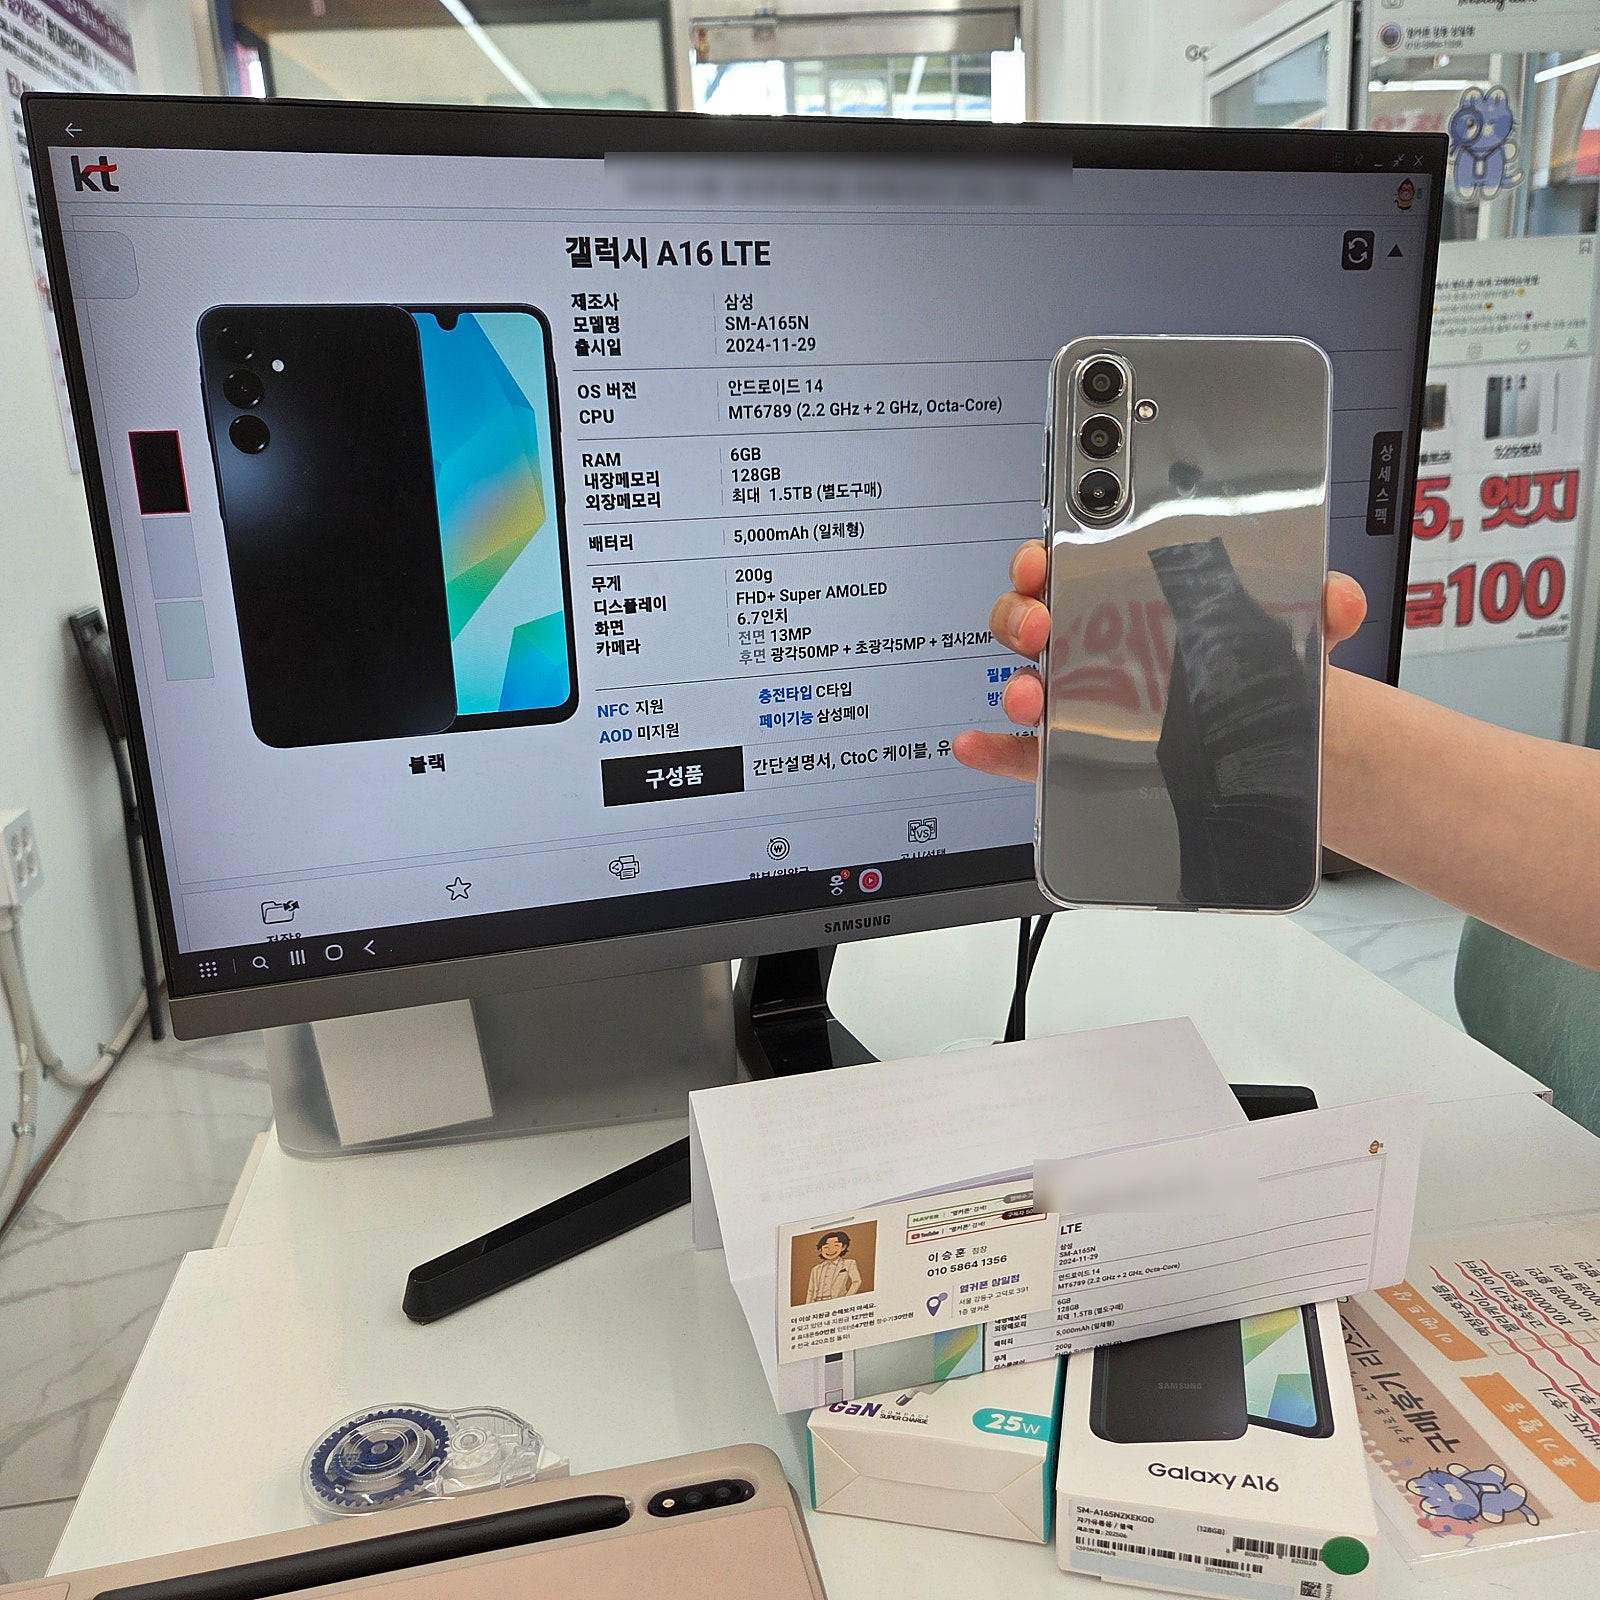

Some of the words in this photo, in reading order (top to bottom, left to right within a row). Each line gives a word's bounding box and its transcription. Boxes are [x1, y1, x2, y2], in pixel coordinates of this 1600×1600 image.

[71, 155, 119, 191] kt
[565, 236, 647, 269] 갤럭시
[657, 240, 713, 267] A16
[721, 240, 771, 266] LTE
[571, 293, 619, 311] 제조사
[725, 294, 754, 311] 삼성
[573, 317, 620, 334] 모델명
[725, 316, 809, 331] SM-A165N
[574, 339, 622, 357] 출시일
[726, 337, 816, 353] 2024-11-29
[577, 384, 601, 400] OS
[606, 381, 637, 400] 버전
[728, 379, 800, 396] 안드로이드
[805, 379, 824, 393] 14
[579, 409, 614, 424] CPU
[728, 404, 792, 420] MT6789
[796, 402, 826, 421] (2.2
[830, 402, 859, 417] GHz
[864, 405, 872, 414] +
[876, 402, 886, 415] 2
[889, 400, 922, 417] GHz,
[926, 396, 1002, 415] Octa-Core)
[582, 452, 621, 468] RAM
[730, 447, 761, 462] 6GB
[584, 470, 660, 490] 내장메모리
[731, 467, 781, 483] 128GB
[1374, 444, 1394, 525] 상세스펙
[585, 491, 662, 511] 외장메모리
[732, 487, 760, 505] 최대
[769, 485, 813, 502] 1.5TB
[816, 481, 883, 502] (별도구매)
[588, 534, 633, 552] 배터리
[734, 525, 809, 546] 5,000mAh
[812, 522, 865, 543] (일체형)
[592, 575, 621, 593] 무게
[735, 568, 773, 584] 200g
[736, 591, 776, 605] FHD+
[780, 588, 822, 604] Super
[825, 582, 887, 599] AMOLED
[594, 595, 667, 616] 디스플레이
[737, 608, 788, 626] 6.7인치
[595, 619, 624, 637] 화면
[738, 629, 766, 646] 전면
[770, 627, 812, 643] 13MP
[596, 638, 641, 657] 카메라
[739, 649, 766, 666] 후면
[770, 644, 839, 663] 광각50MP
[843, 645, 851, 654] +
[855, 637, 926, 655] 초광각5MP
[930, 638, 938, 647] +
[758, 685, 812, 704] 충전타입
[815, 681, 852, 699] C타입
[597, 703, 629, 718] NFC
[635, 699, 664, 716] 지원
[759, 710, 813, 729] 페이기능
[816, 704, 869, 724] 삼성페이
[599, 728, 633, 744] AOD
[637, 722, 680, 741] 미지원
[408, 752, 446, 775] 블랙
[753, 752, 836, 776] 간단설명서,
[840, 749, 879, 766] CtoC
[883, 740, 932, 763] 케이블,
[645, 765, 704, 790] 구성품
[824, 914, 892, 933] SAMSUNG
[1060, 1222, 1082, 1235] LTE
[1059, 1246, 1096, 1258] SM-A165N
[1060, 1243, 1073, 1251] 삼성
[927, 1266, 947, 1277] 010
[950, 1260, 979, 1273] 5864
[981, 1255, 1008, 1267] 1356
[1059, 1253, 1099, 1266] 2024-11-29
[992, 1273, 1020, 1288] 상일점
[1058, 1279, 1086, 1290] MT6789
[1087, 1277, 1101, 1286] (2.2
[1101, 1274, 1116, 1282] GHz
[1128, 1270, 1144, 1278] GHz,
[1145, 1261, 1181, 1274] Octa-Core)
[1092, 1268, 1100, 1276] 14
[1461, 1260, 1495, 1285] 어댑터
[1500, 1271, 1529, 1287] 할인
[1525, 1267, 1553, 1284] 할인
[1549, 1265, 1578, 1281] 할인
[1016, 1286, 1029, 1295] 391
[1056, 1298, 1072, 1306] 6GB
[1057, 1304, 1080, 1313] 128GB
[1432, 1283, 1491, 1337] 액정보호필름
[1468, 1289, 1520, 1333] 젤리케이스
[1490, 1286, 1547, 1329] 고속충전기
[1522, 1288, 1573, 1326] 10,000원
[1546, 1286, 1599, 1322] 10,000원
[1073, 1310, 1093, 1319] 1.5TB
[1392, 1290, 1453, 1343] 이벤트상
[1056, 1325, 1089, 1336] 5,000mAh
[1055, 1343, 1072, 1351] 200g
[1157, 1381, 1202, 1390] SAMSUNG
[1565, 1384, 1596, 1405] 후기
[1538, 1388, 1568, 1409] 후기
[828, 1400, 883, 1418] GaN
[1370, 1372, 1461, 1453] 구매후기
[880, 1413, 902, 1422] SUPER
[902, 1415, 929, 1425] CHARGE
[985, 1412, 1041, 1435] 25W
[1374, 1407, 1414, 1444] 슬기로운
[1502, 1402, 1577, 1467] 후기활동
[1148, 1462, 1236, 1490] Galaxy
[1241, 1474, 1279, 1493] A16
[1196, 1524, 1225, 1536] (128GB)
